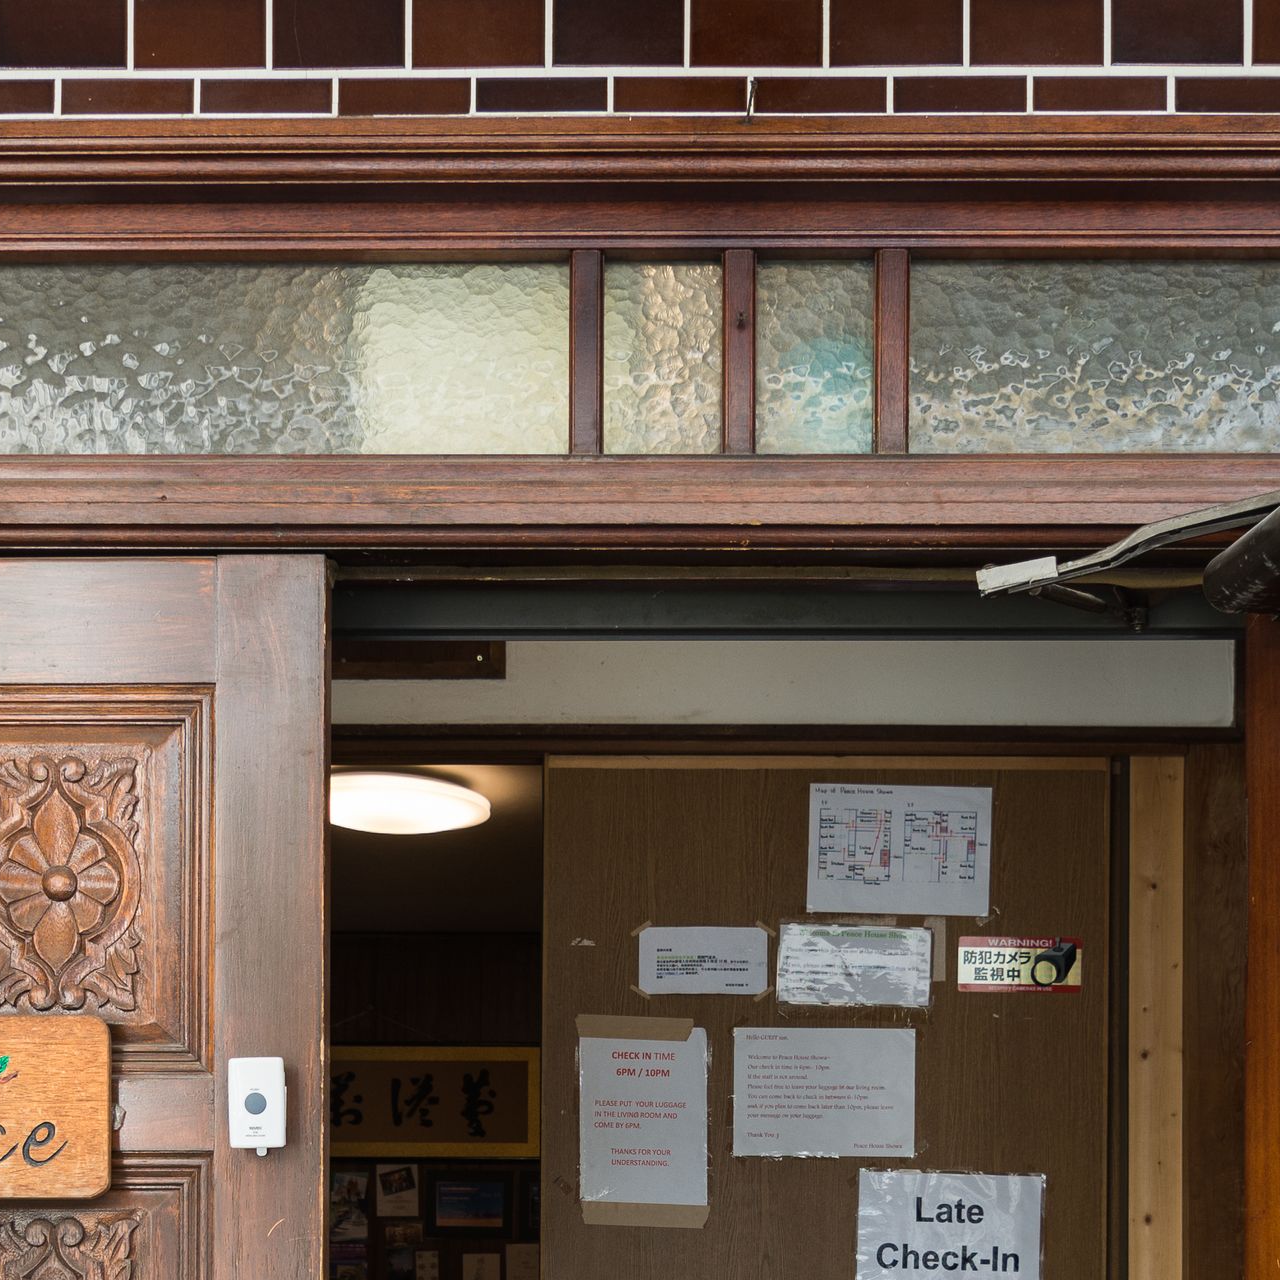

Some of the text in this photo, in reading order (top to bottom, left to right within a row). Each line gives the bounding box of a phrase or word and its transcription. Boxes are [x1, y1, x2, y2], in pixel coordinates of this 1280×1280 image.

[841, 929, 863, 938] Peace
[864, 930, 887, 938] House
[988, 938, 1053, 948] WARNING!
[963, 950, 1031, 965] 防犯カメラ
[974, 967, 1021, 982] 監視中
[611, 1051, 676, 1061] CHECK IN TIME
[616, 1068, 670, 1078] 6PM / 10PM
[611, 1159, 670, 1167] UNDERSTANDING.
[916, 1197, 984, 1224] Late
[876, 1243, 1020, 1272] Check-In
